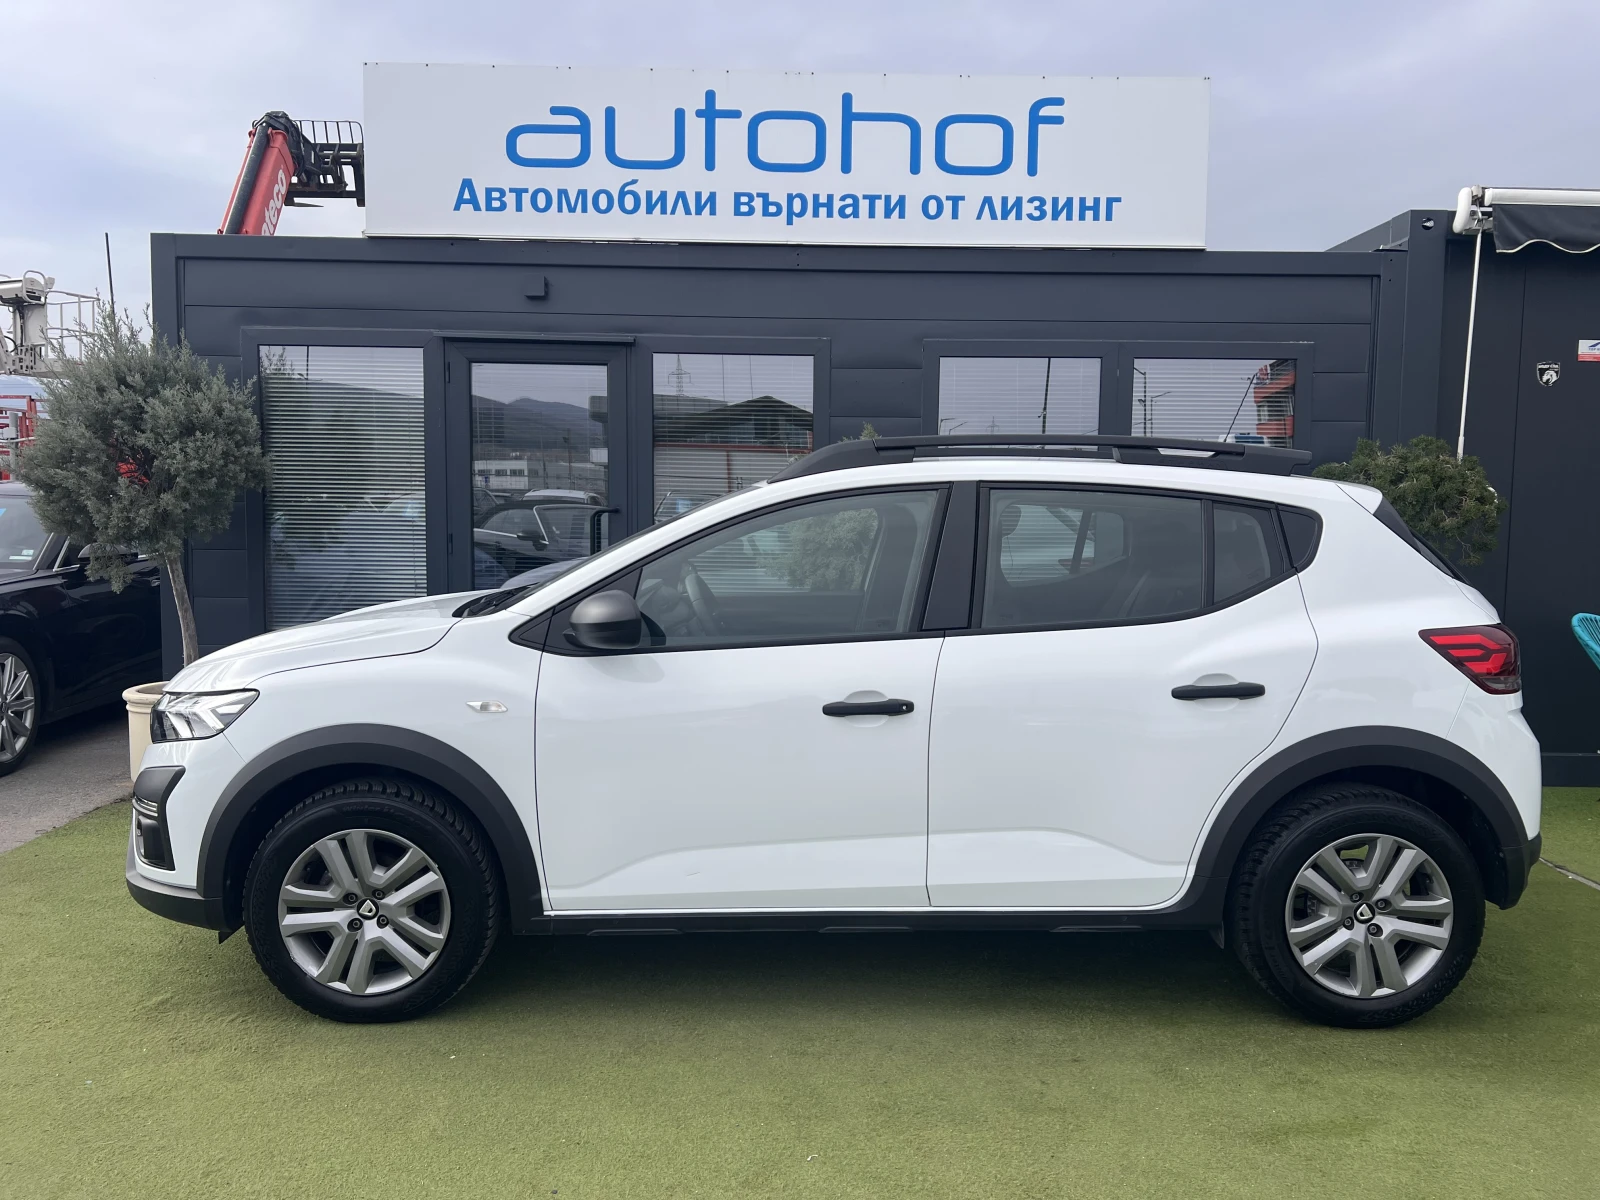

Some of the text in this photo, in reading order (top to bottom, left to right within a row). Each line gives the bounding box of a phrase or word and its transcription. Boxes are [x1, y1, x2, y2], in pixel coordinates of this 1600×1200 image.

[506, 89, 1065, 177] autohof
[454, 178, 1122, 226] Автомобили върнати от лизинг
